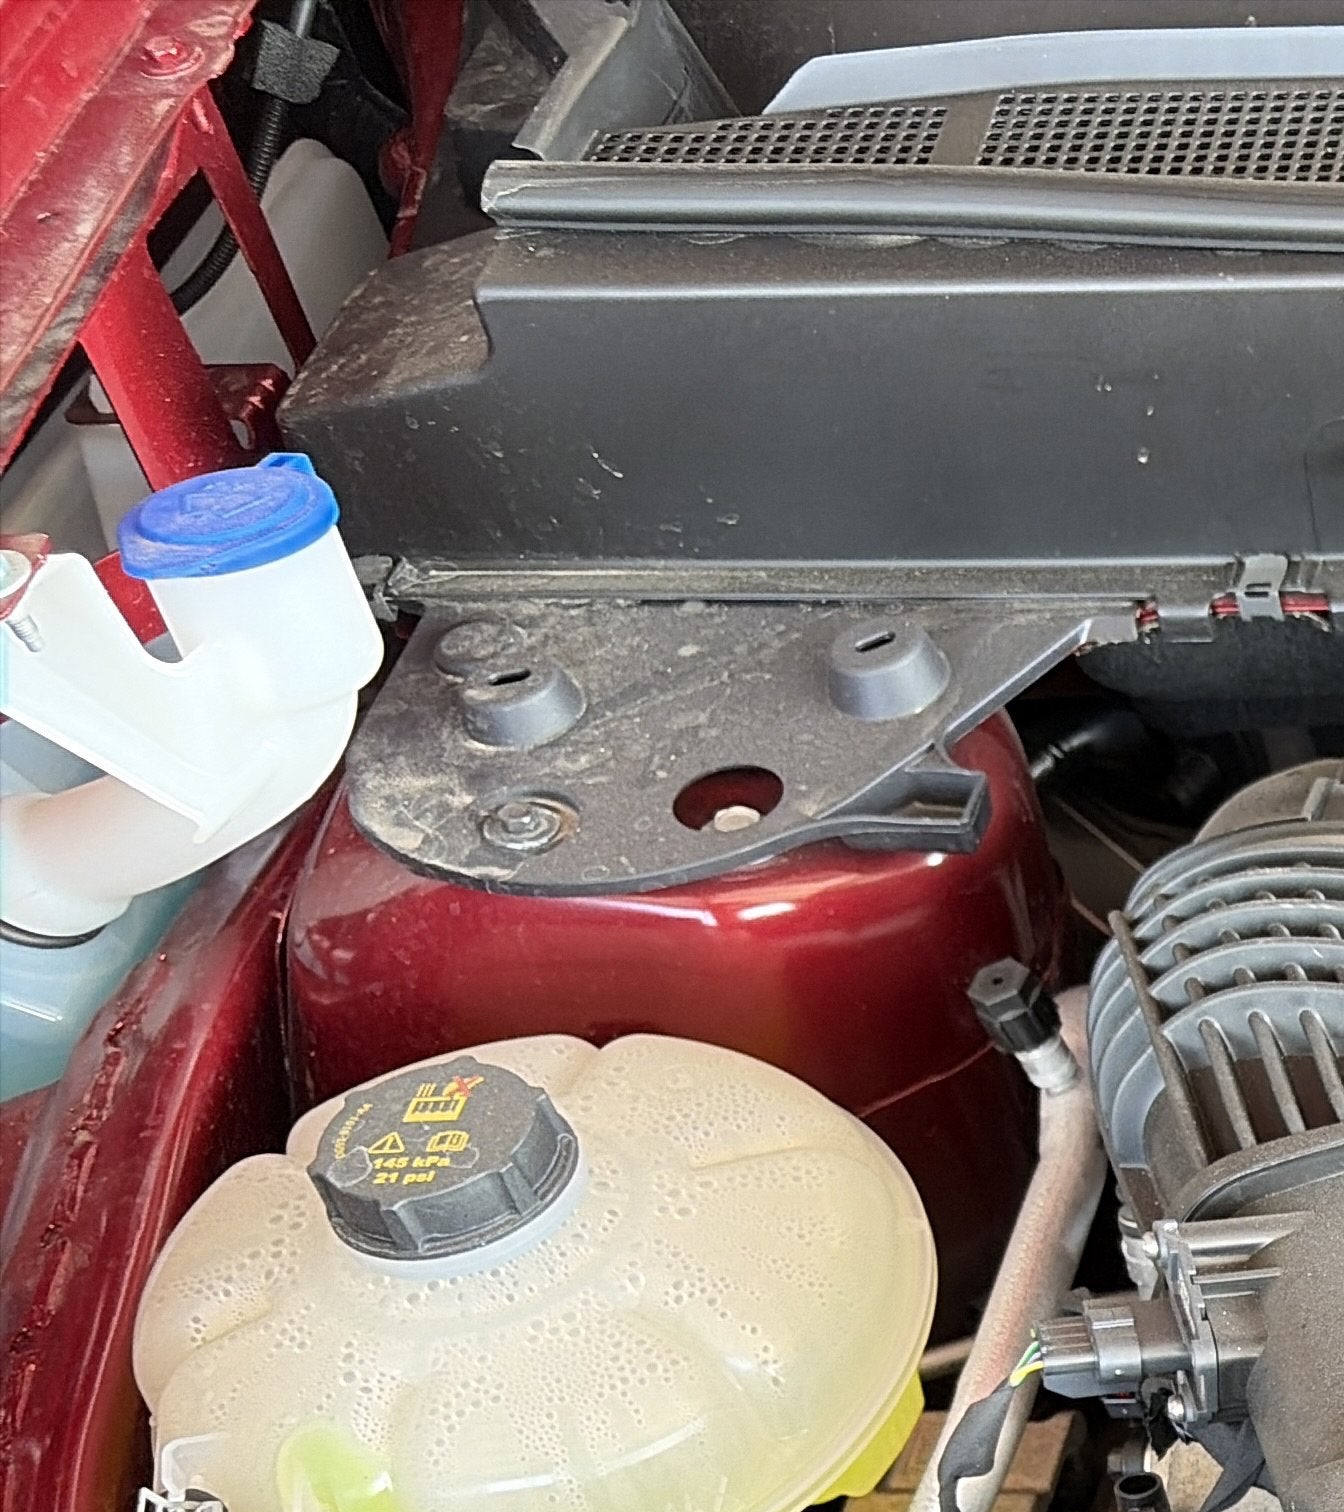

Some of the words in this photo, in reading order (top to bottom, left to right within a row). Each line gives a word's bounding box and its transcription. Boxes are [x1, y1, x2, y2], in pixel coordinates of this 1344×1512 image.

[373, 1157, 408, 1169] 145
[413, 1156, 451, 1168] kPa
[373, 1172, 399, 1184] 21
[403, 1171, 436, 1186] psi
